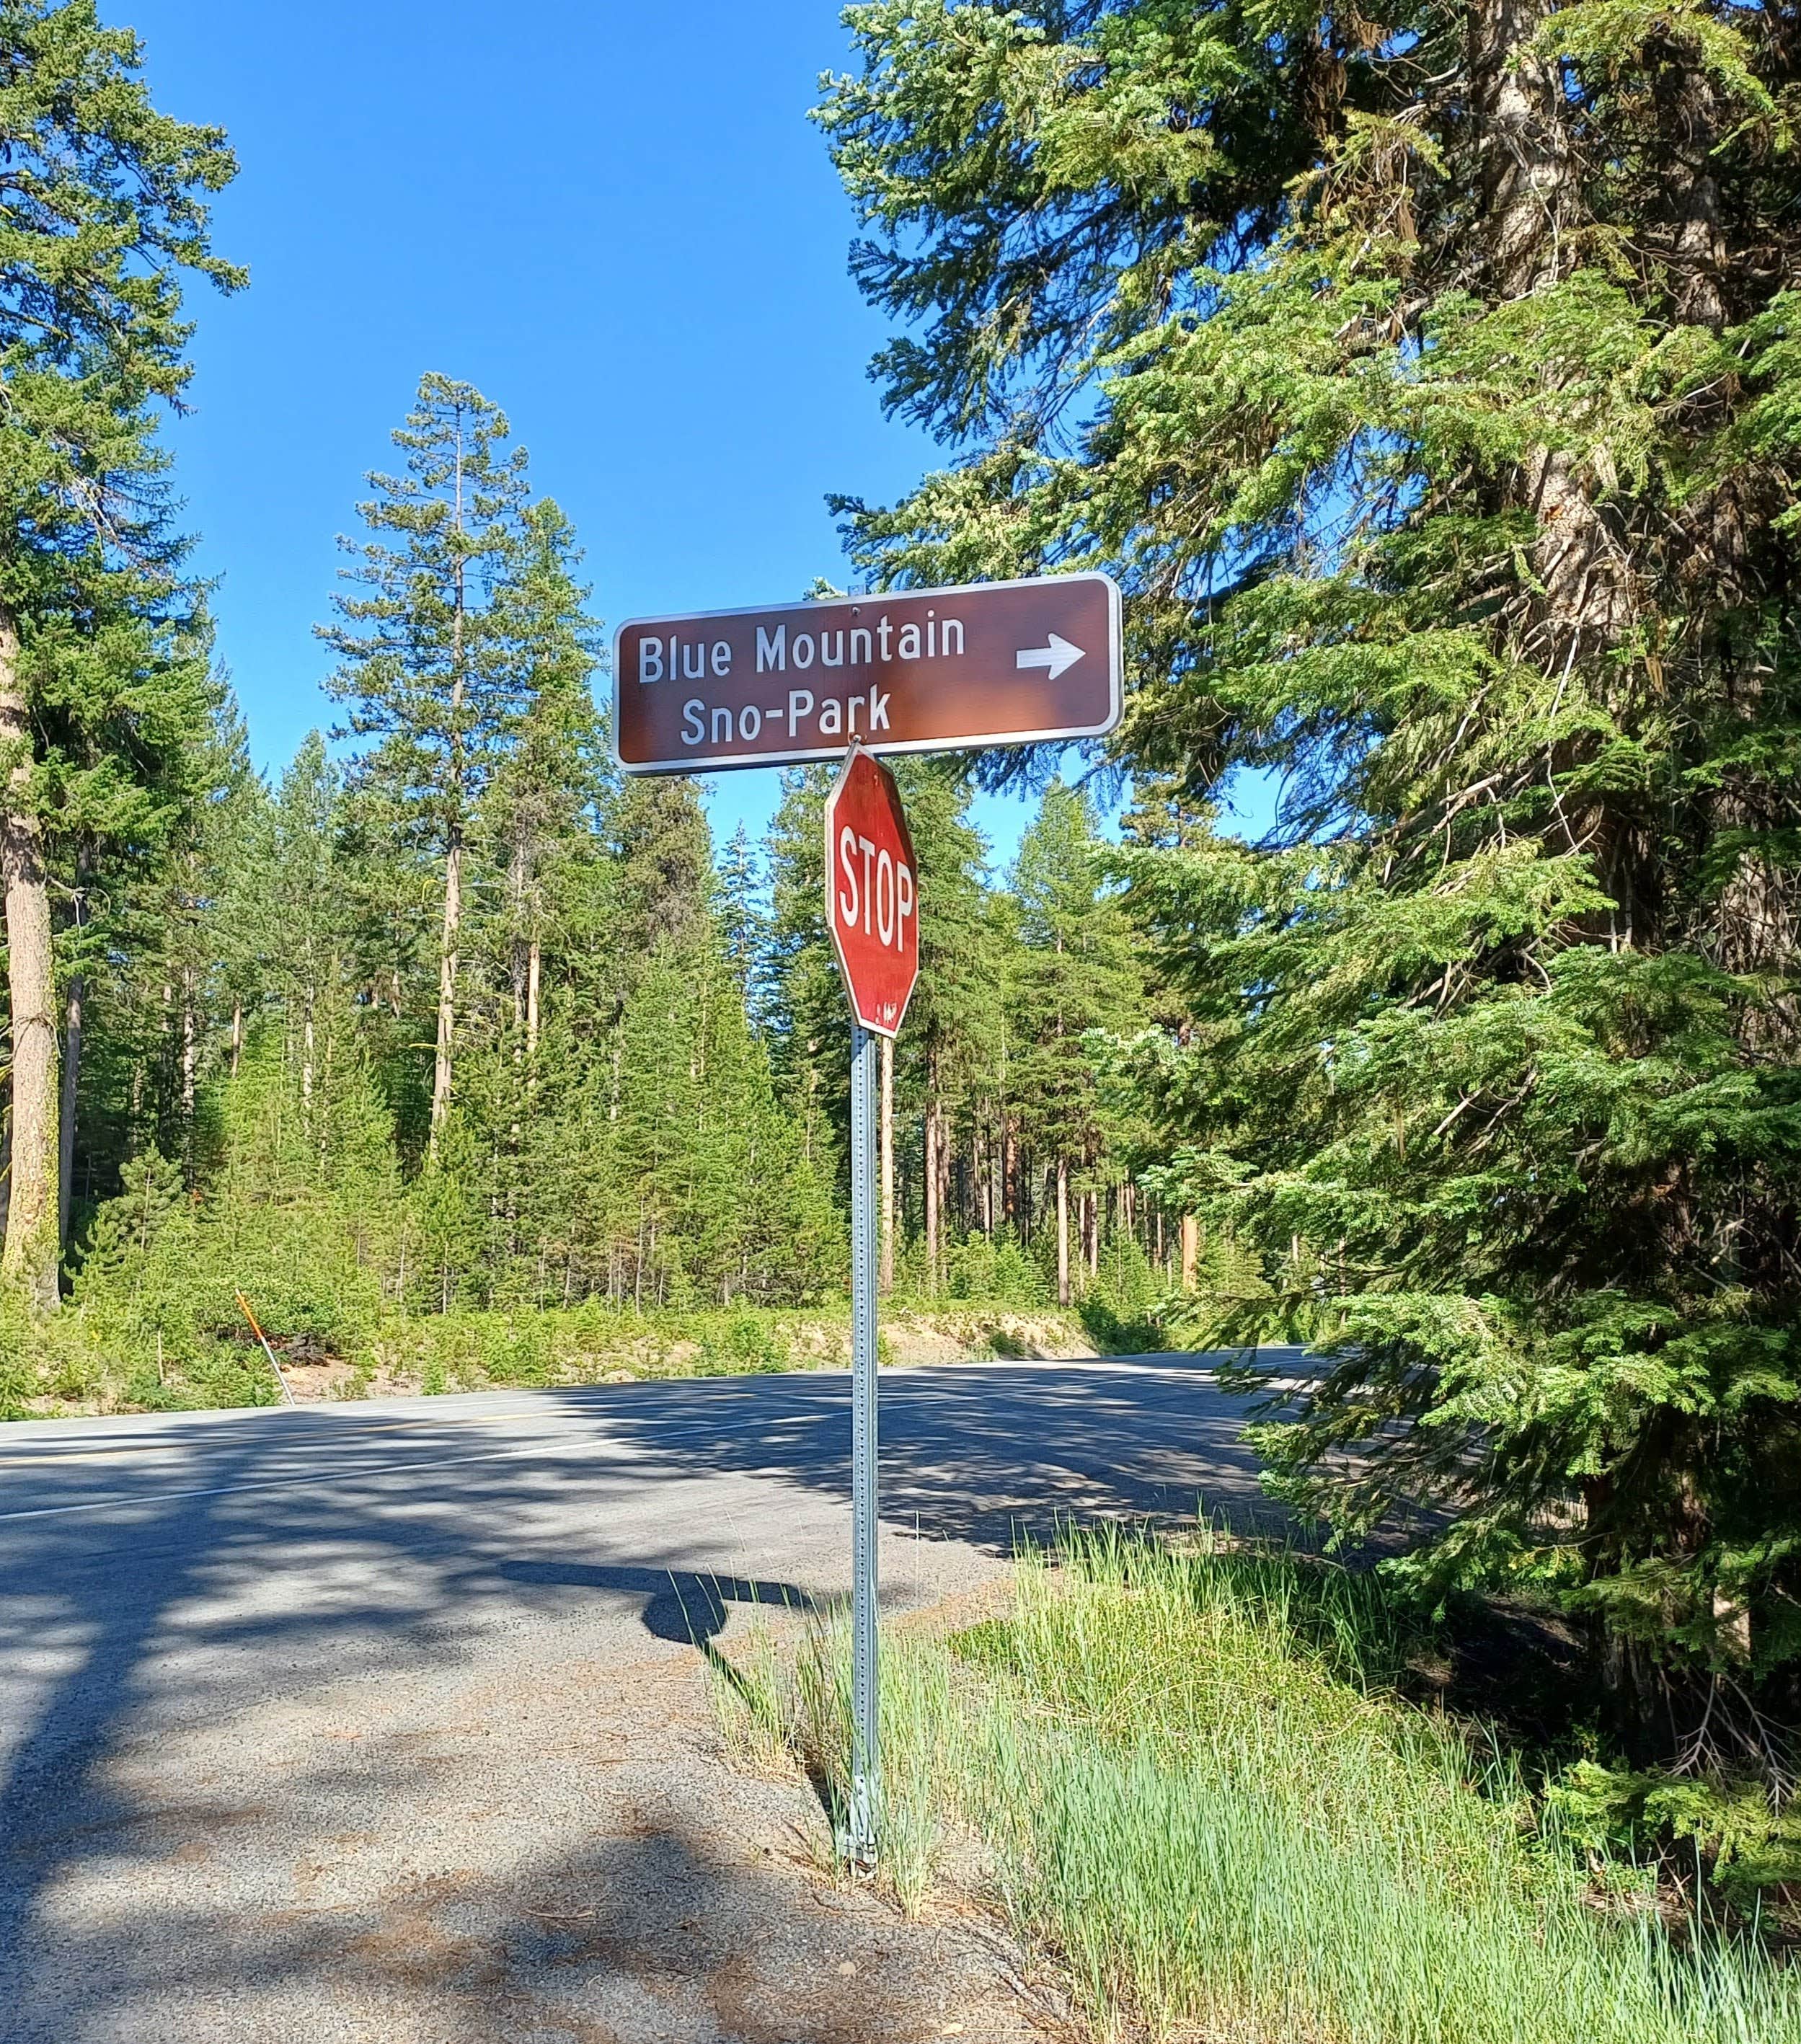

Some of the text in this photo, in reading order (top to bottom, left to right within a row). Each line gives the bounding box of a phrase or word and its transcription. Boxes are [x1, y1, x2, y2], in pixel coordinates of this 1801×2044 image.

[639, 609, 965, 683] Blue Mountain
[680, 684, 891, 746] Sno-Park
[839, 826, 913, 952] STOP
